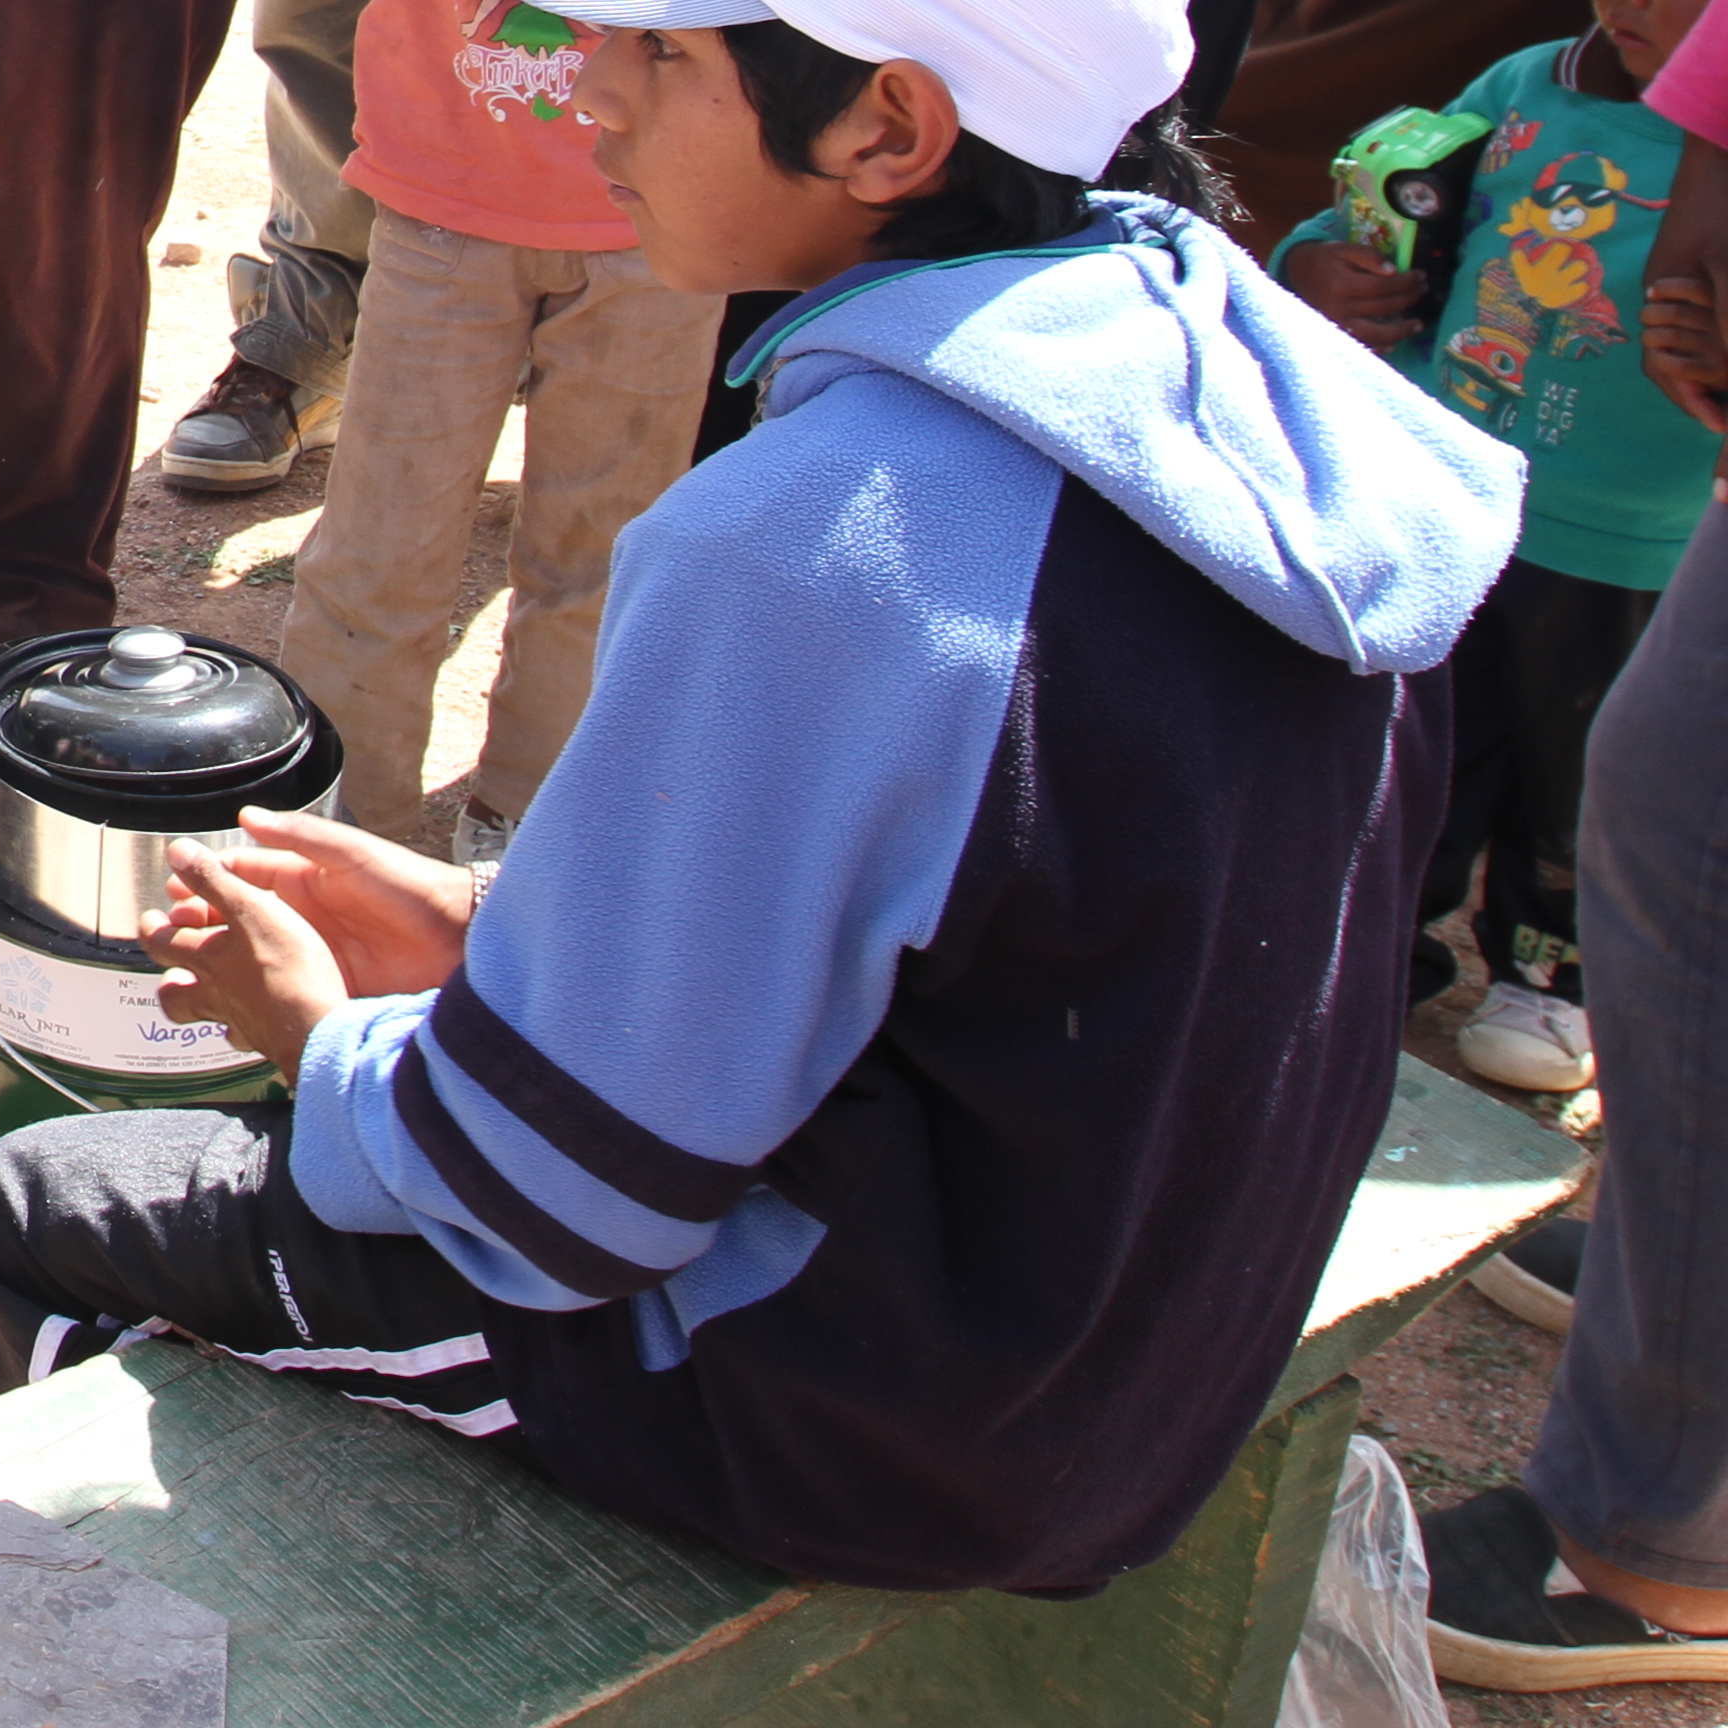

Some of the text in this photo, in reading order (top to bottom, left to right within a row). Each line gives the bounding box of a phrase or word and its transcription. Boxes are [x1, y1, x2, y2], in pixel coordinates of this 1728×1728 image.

[1543, 379, 1579, 408] WE
[1537, 400, 1576, 431] DIG
[137, 1020, 229, 1048] Vargas
